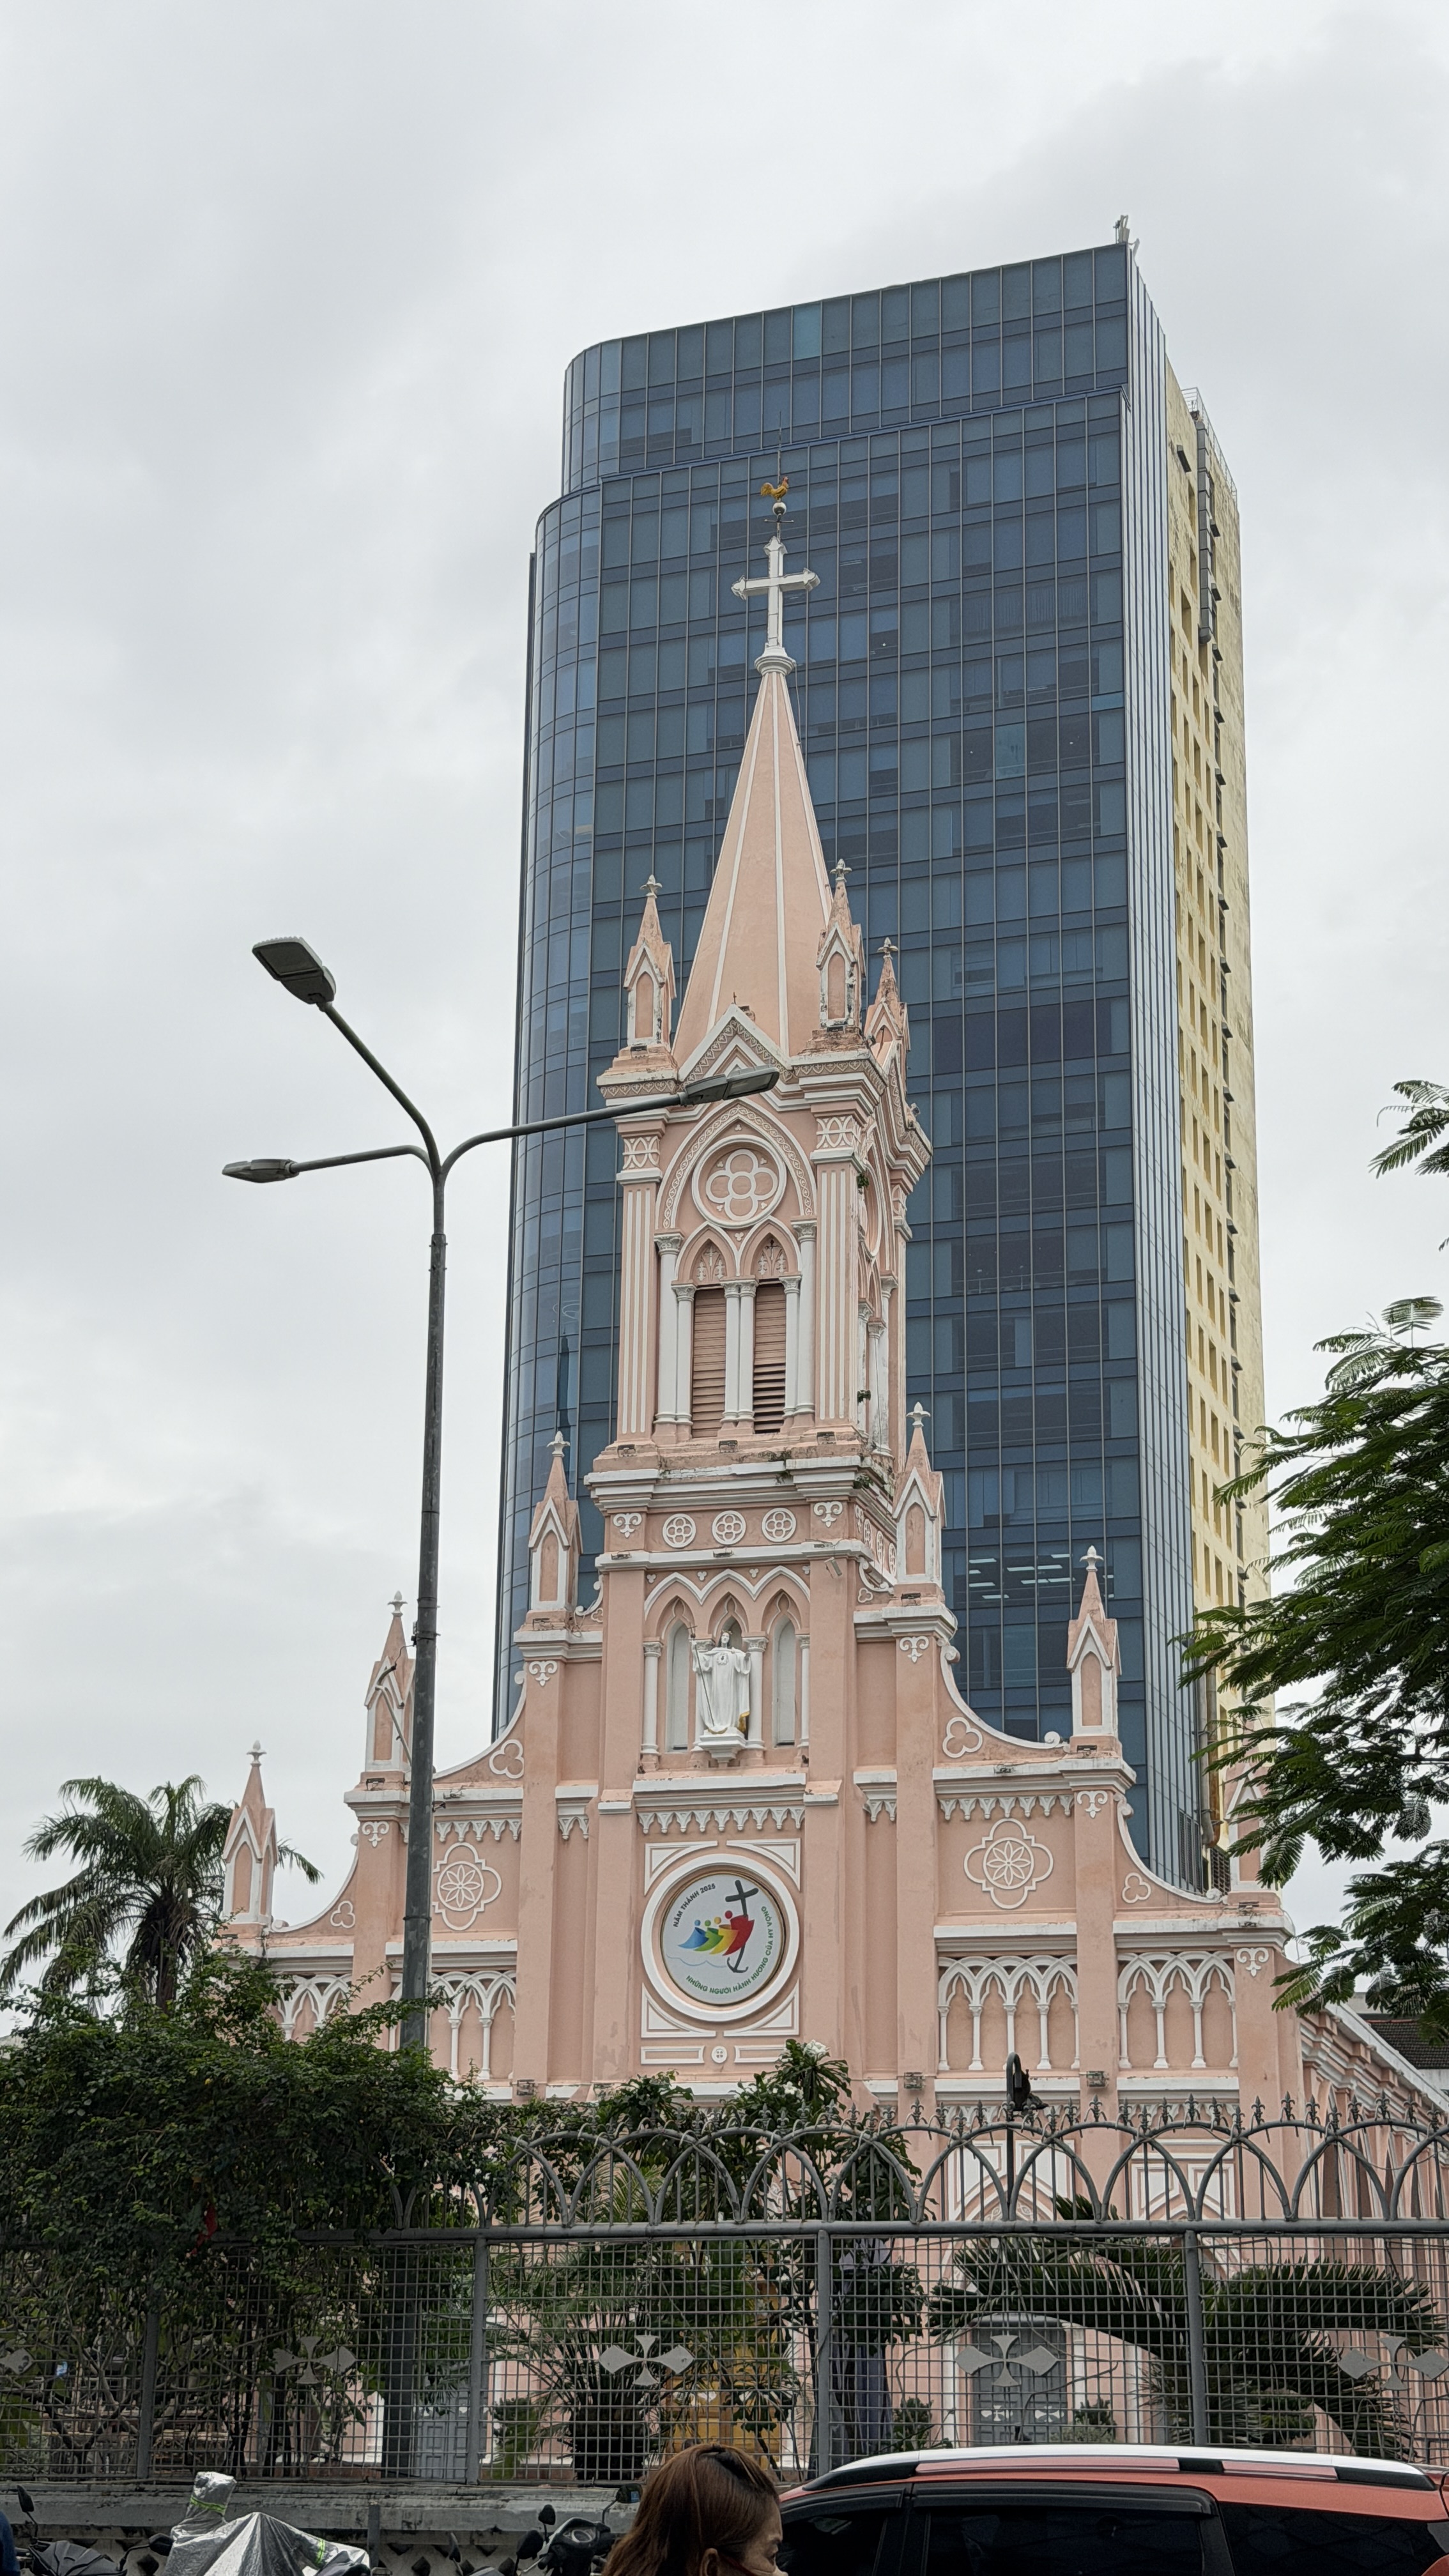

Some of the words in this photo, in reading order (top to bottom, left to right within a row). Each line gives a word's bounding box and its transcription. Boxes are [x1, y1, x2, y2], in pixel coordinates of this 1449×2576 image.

[673, 1910, 683, 1927] NĂM
[680, 1890, 700, 1910] THÁNH
[700, 1883, 716, 1894] 2025
[761, 1906, 772, 1927] VỌNG
[767, 1928, 774, 1938] HY
[751, 1957, 769, 1981] HƯƠNG
[733, 1978, 751, 1992] HÀNH
